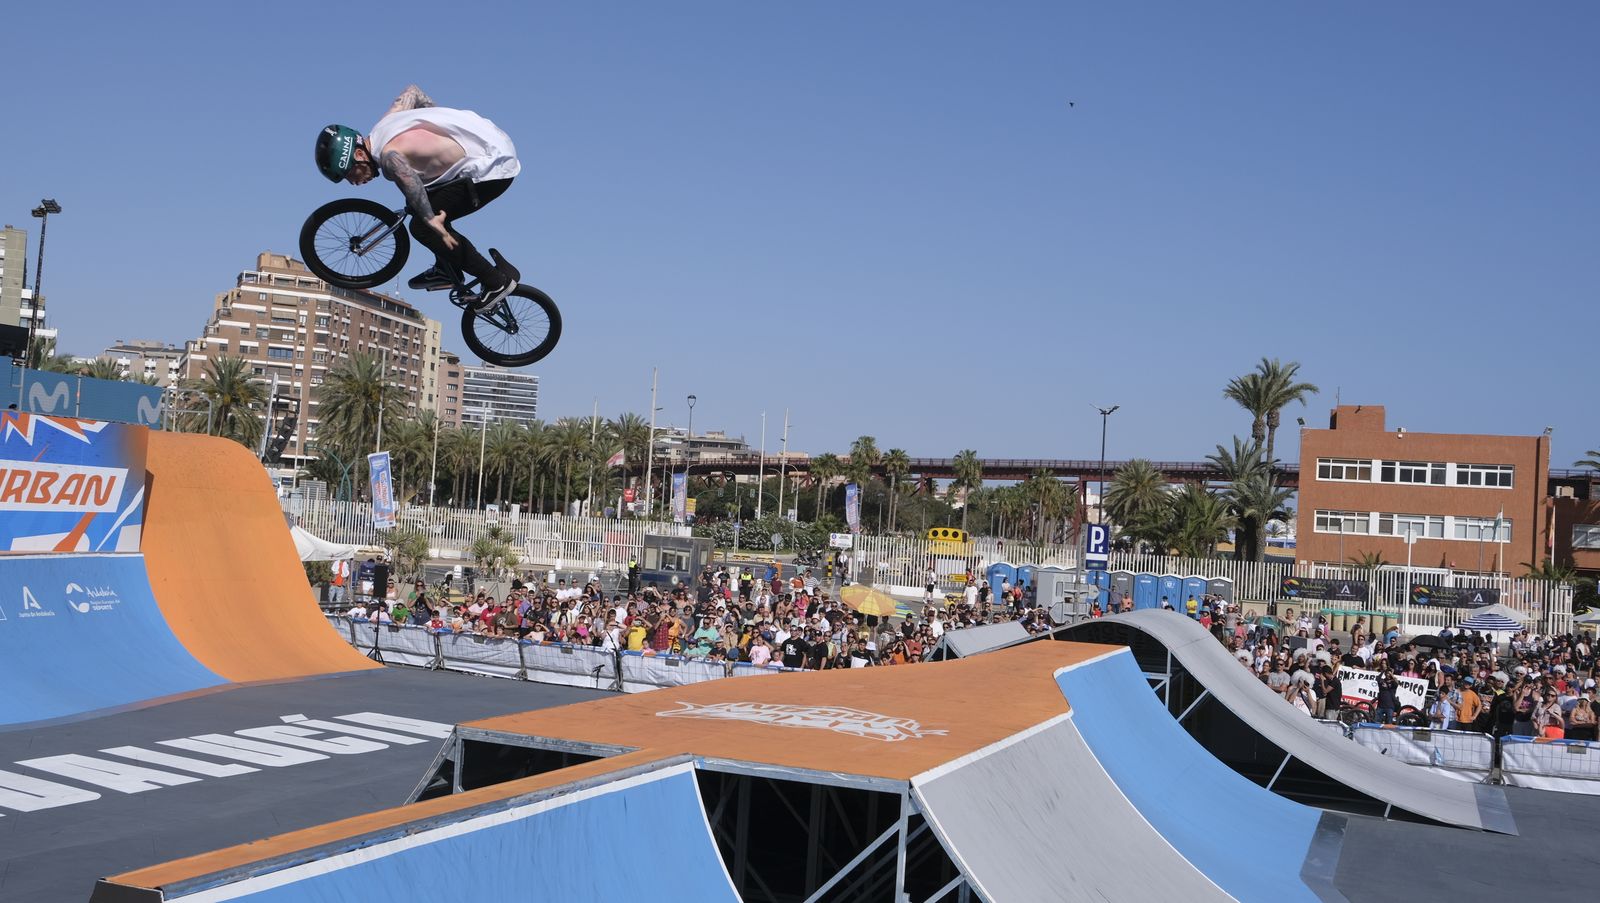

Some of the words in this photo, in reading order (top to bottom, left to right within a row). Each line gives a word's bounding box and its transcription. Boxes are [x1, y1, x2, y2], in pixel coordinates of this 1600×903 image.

[339, 135, 351, 168] CANNA
[0, 469, 117, 506] RBAN
[1091, 526, 1105, 552] P
[1338, 670, 1357, 681] BMX
[1397, 680, 1424, 697] MPICO
